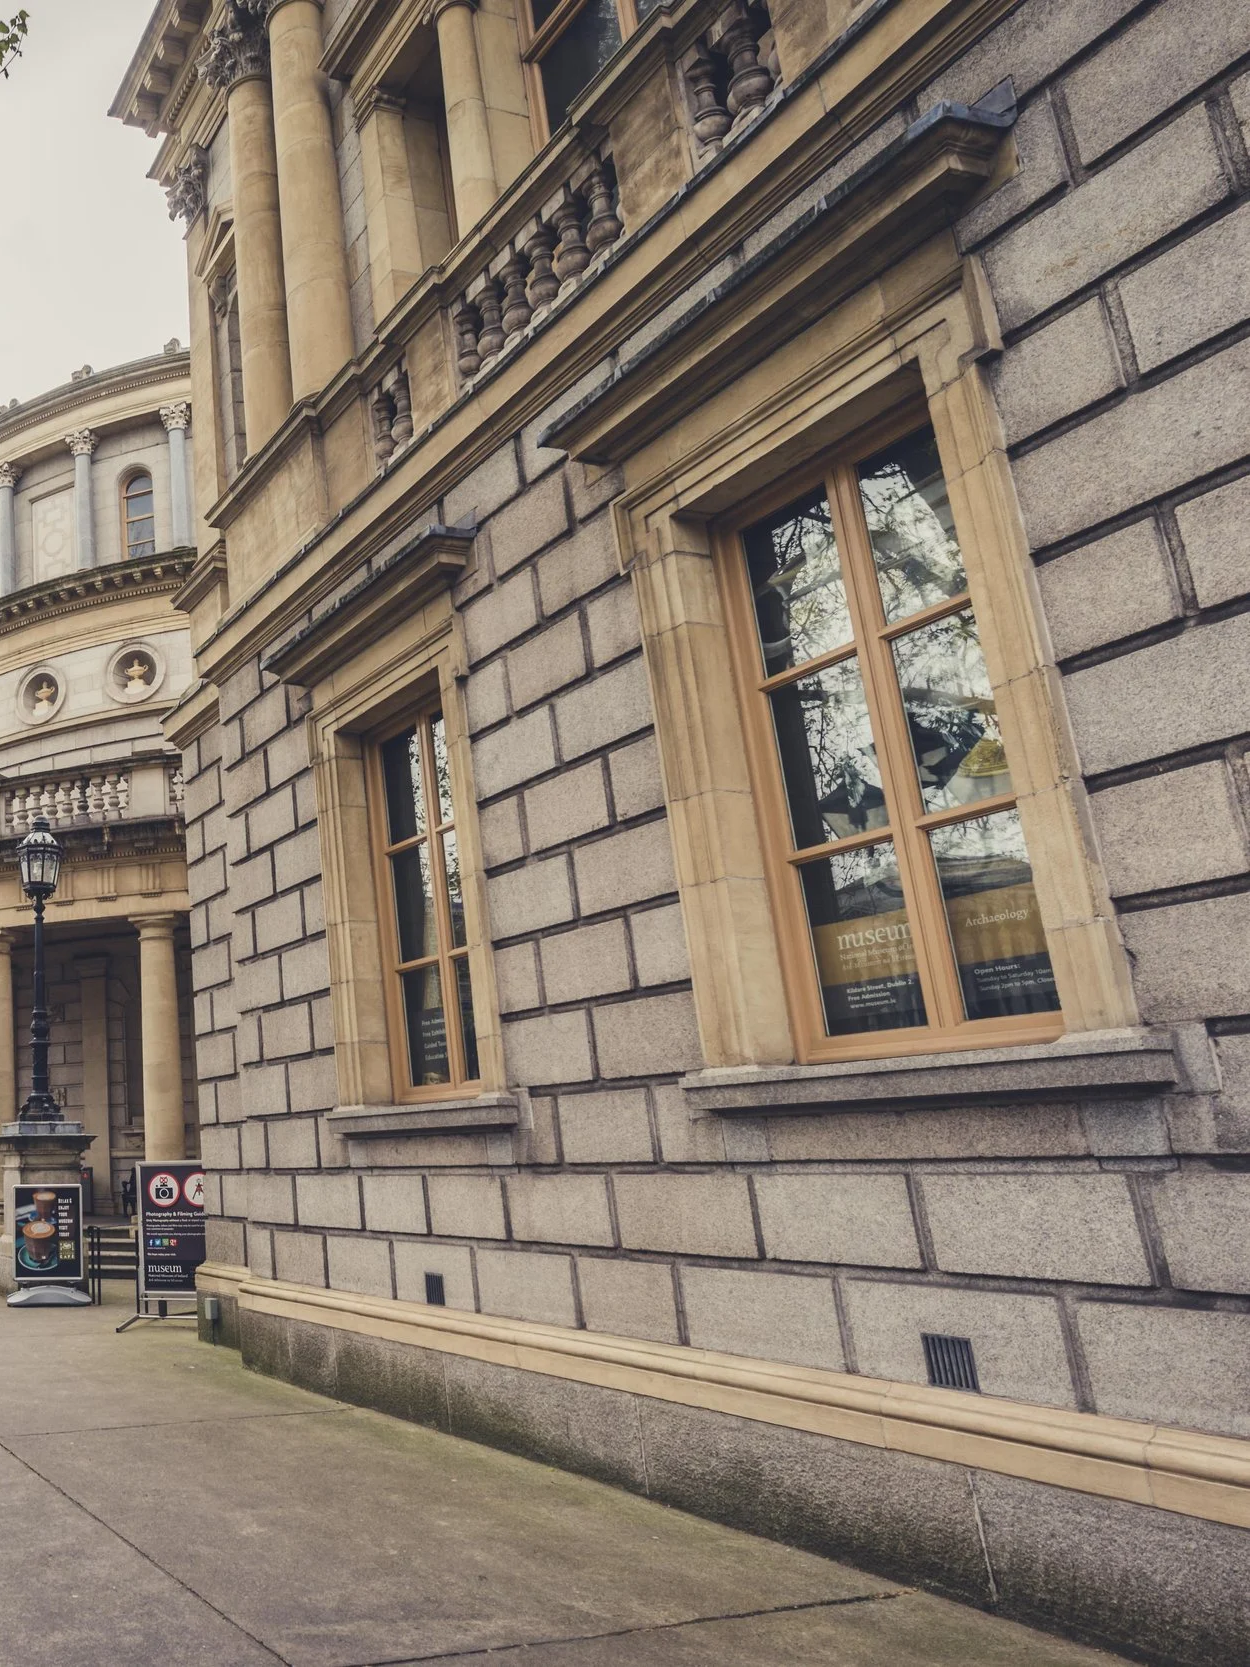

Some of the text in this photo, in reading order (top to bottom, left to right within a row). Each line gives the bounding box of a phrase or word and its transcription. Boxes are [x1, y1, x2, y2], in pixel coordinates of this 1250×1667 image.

[965, 908, 1029, 928] Archaeology
[836, 923, 911, 951] museum
[974, 963, 1021, 976] Open Hours:
[887, 980, 907, 989] Dublin
[847, 991, 891, 1003] Free Admission
[146, 1211, 172, 1219] Photography
[177, 1211, 192, 1219] Filming
[148, 1265, 182, 1273] museum
